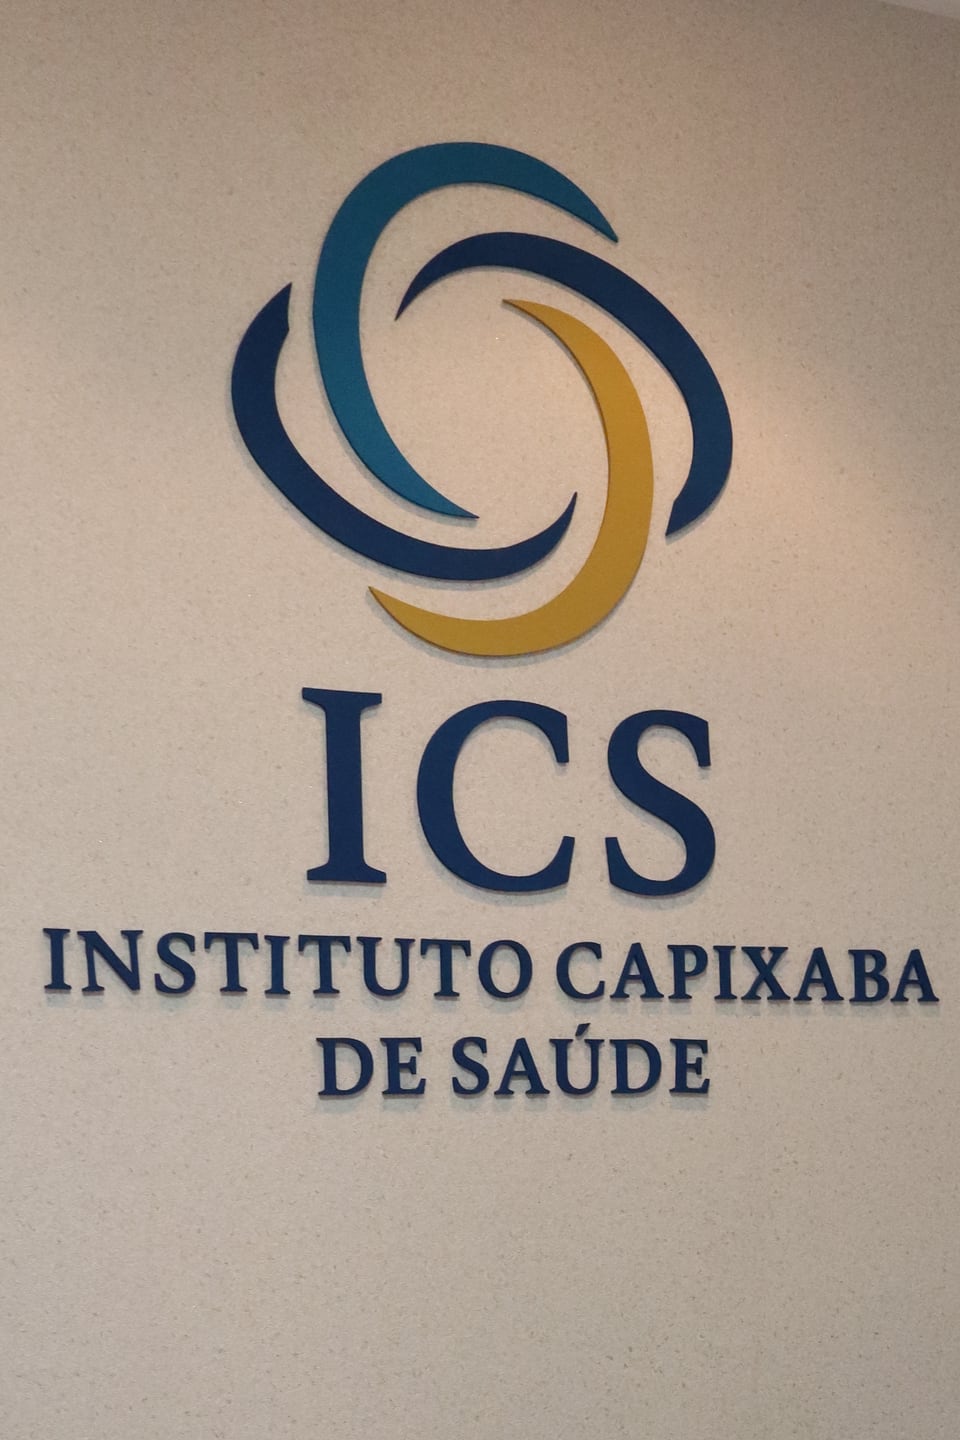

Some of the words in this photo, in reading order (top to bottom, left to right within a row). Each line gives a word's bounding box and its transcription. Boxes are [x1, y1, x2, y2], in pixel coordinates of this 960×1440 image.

[302, 687, 717, 897] ICS
[44, 927, 533, 999] INSTITUTO
[555, 942, 940, 1004] CAPIXABA
[318, 1036, 427, 1097] DE
[451, 1022, 711, 1096] SAÚDE
